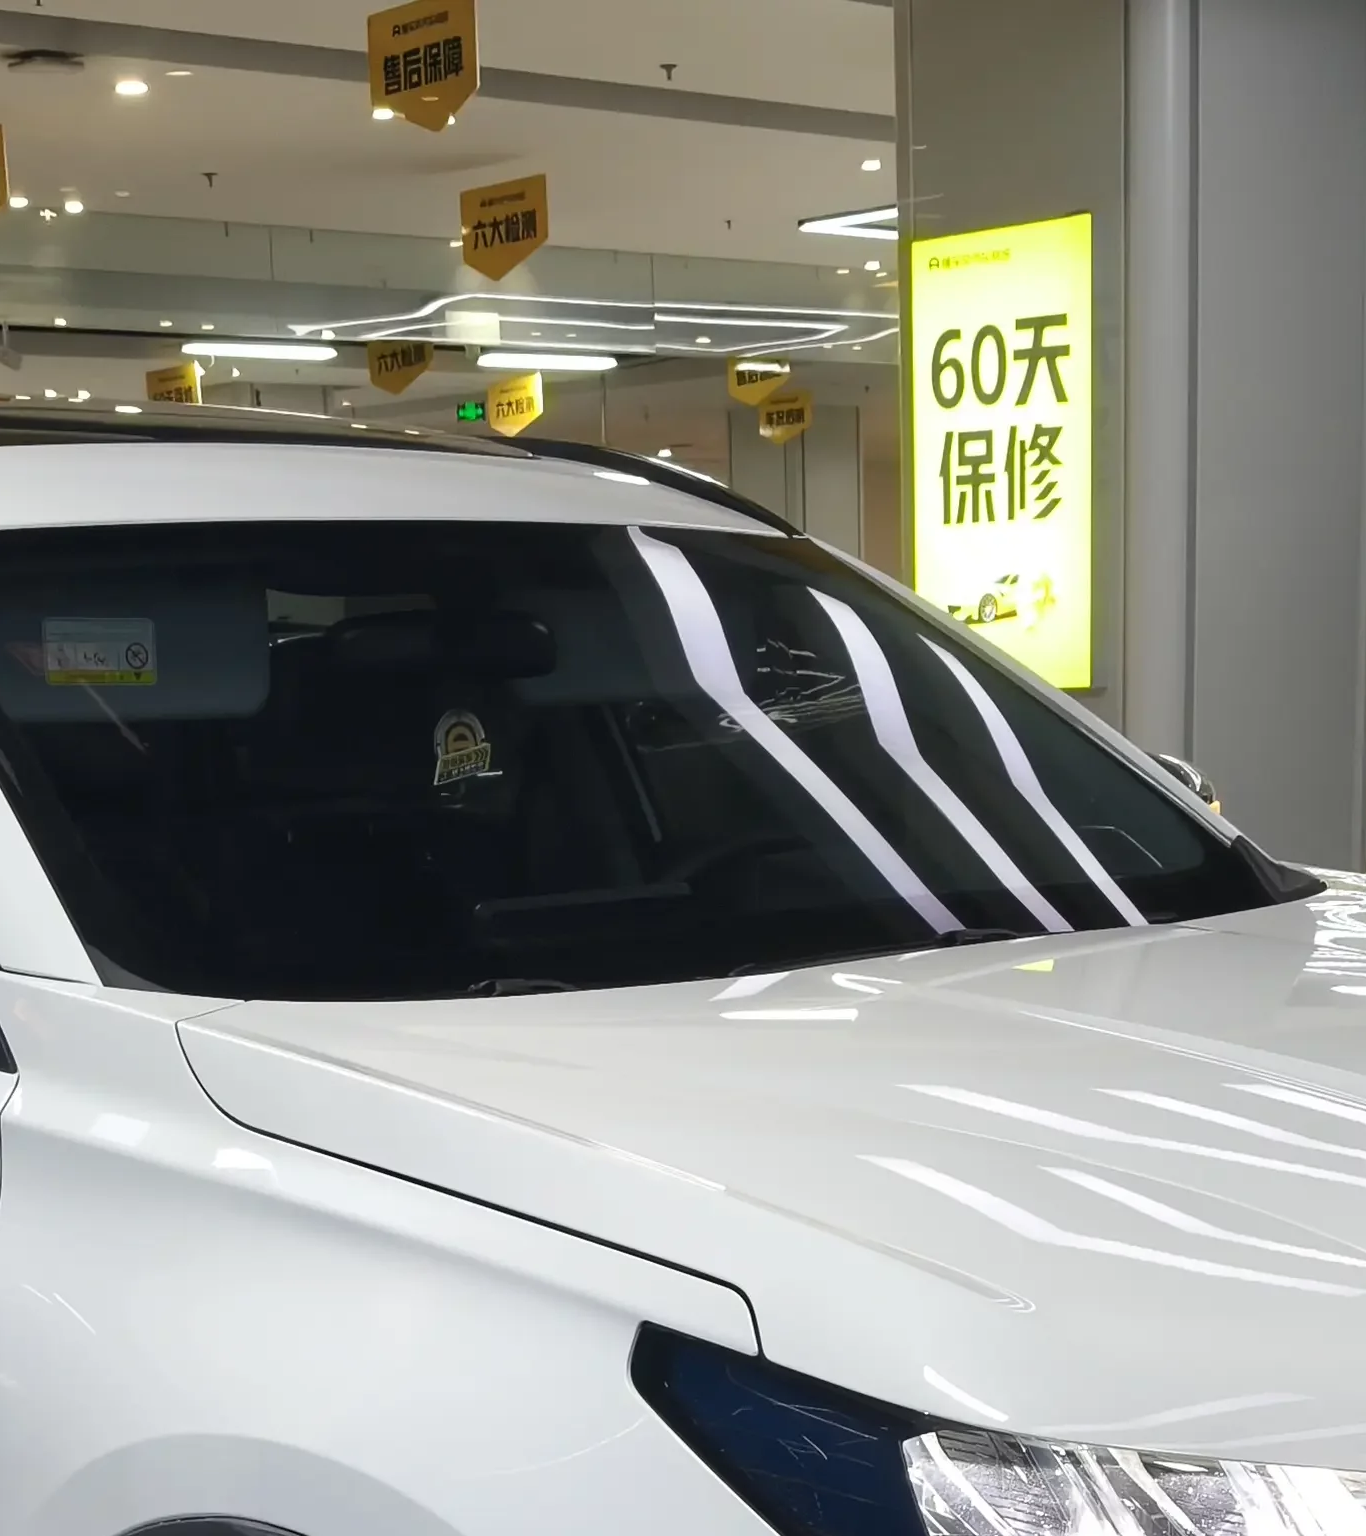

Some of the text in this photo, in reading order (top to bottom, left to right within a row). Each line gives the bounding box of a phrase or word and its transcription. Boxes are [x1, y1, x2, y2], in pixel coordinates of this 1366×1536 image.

[383, 36, 464, 96] 售后保障
[472, 208, 537, 251] 六大检测
[931, 313, 1071, 410] 60天
[939, 424, 1064, 525] 保修
